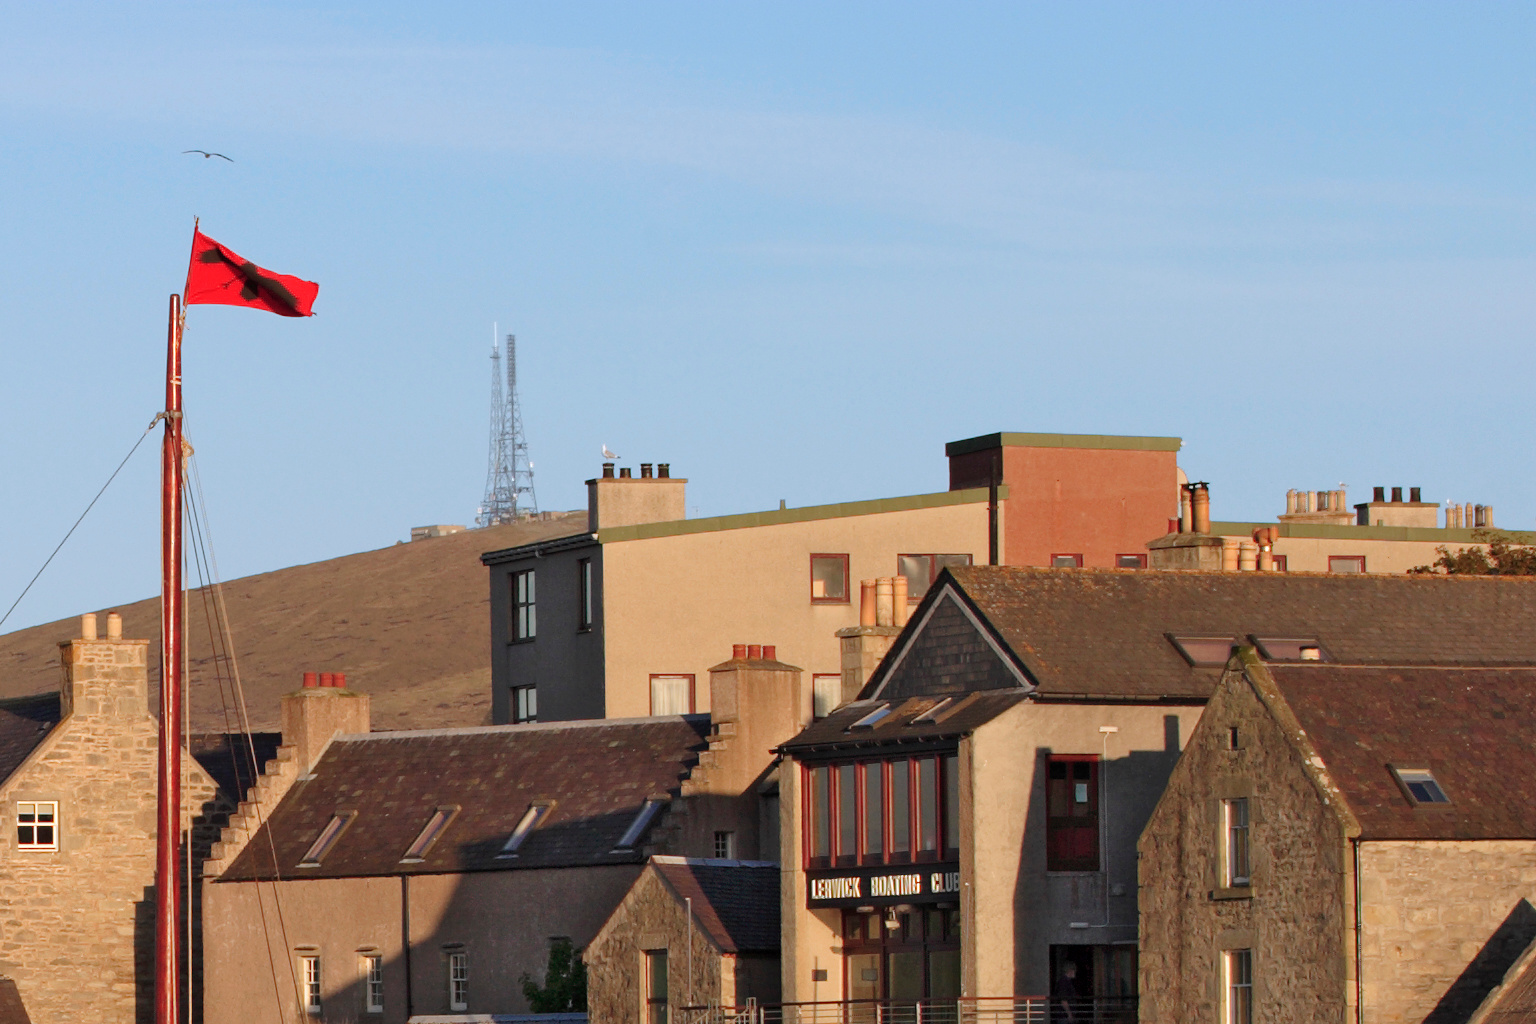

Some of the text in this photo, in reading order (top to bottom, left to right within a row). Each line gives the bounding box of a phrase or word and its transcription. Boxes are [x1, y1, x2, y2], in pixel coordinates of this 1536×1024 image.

[811, 871, 960, 899] LERWICK BOATING CLUB
